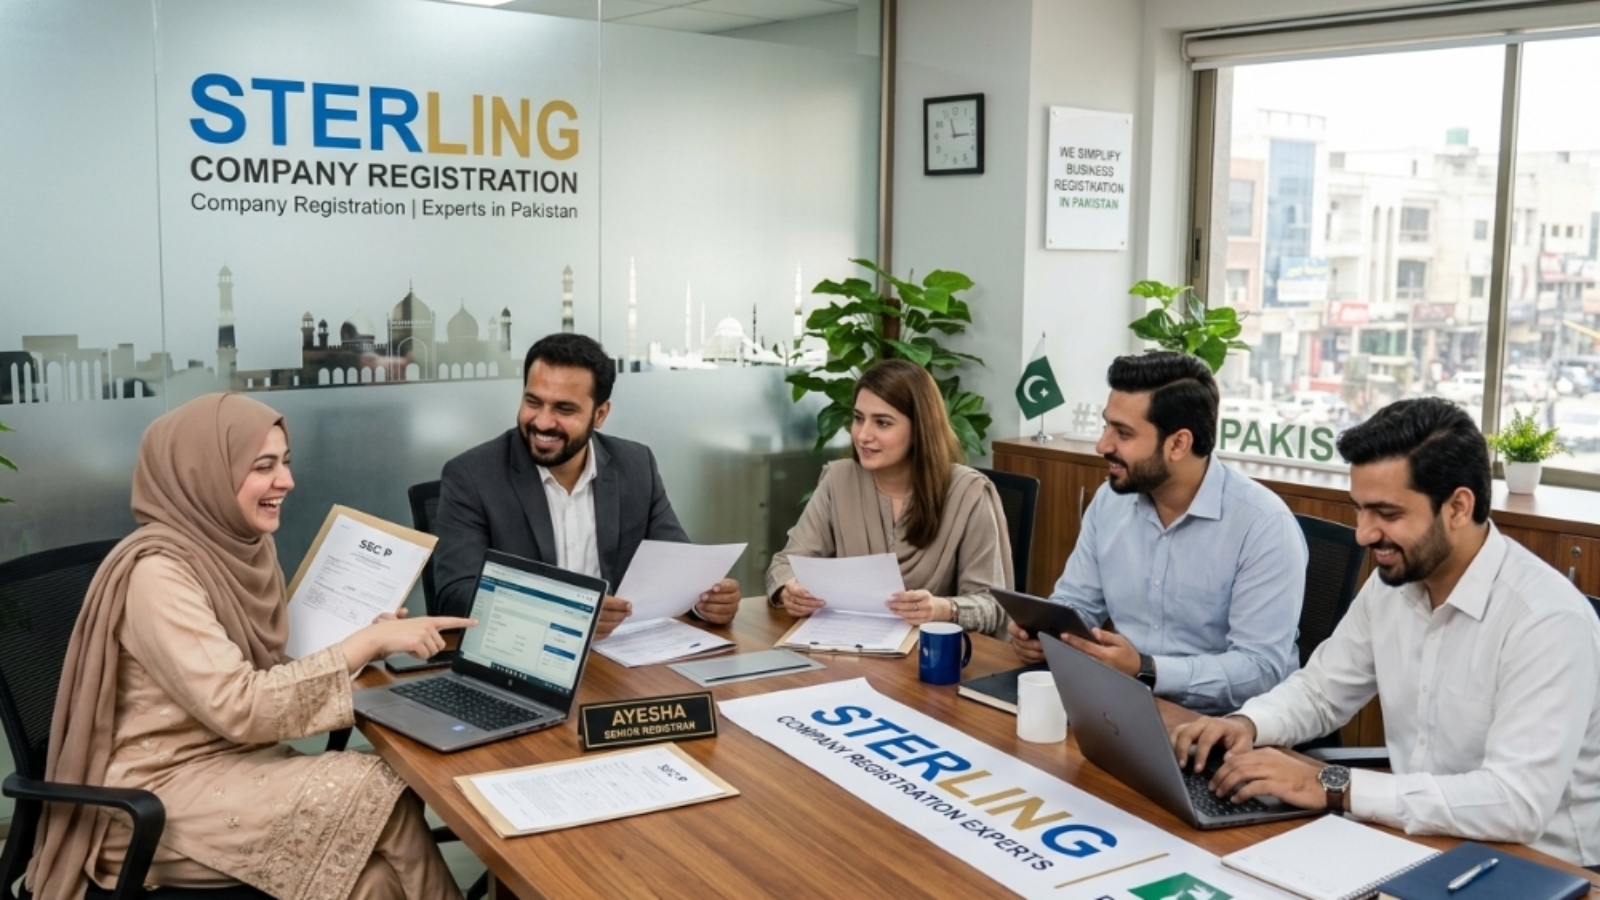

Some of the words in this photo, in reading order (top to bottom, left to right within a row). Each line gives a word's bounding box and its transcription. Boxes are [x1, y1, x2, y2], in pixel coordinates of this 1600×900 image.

[190, 73, 579, 160] STERLING
[1060, 146, 1075, 159] WE
[1078, 147, 1121, 161] SIMPLIFY
[1066, 163, 1115, 177] BUSINESS
[190, 155, 359, 187] COMPANY
[368, 163, 578, 194] REGISTRATION
[190, 192, 287, 216] Company
[294, 195, 406, 218] Registration
[422, 199, 486, 220] Experts
[491, 201, 505, 217] in
[511, 201, 578, 219] Pakistan
[1060, 197, 1070, 208] IN
[1219, 418, 1335, 462] PAKIS
[612, 703, 687, 726] AYESHA
[776, 715, 853, 753] COMPANY
[842, 750, 967, 821] REGISTRATION
[958, 819, 1055, 872] EXPERTS
[811, 705, 1118, 858] STERLING
